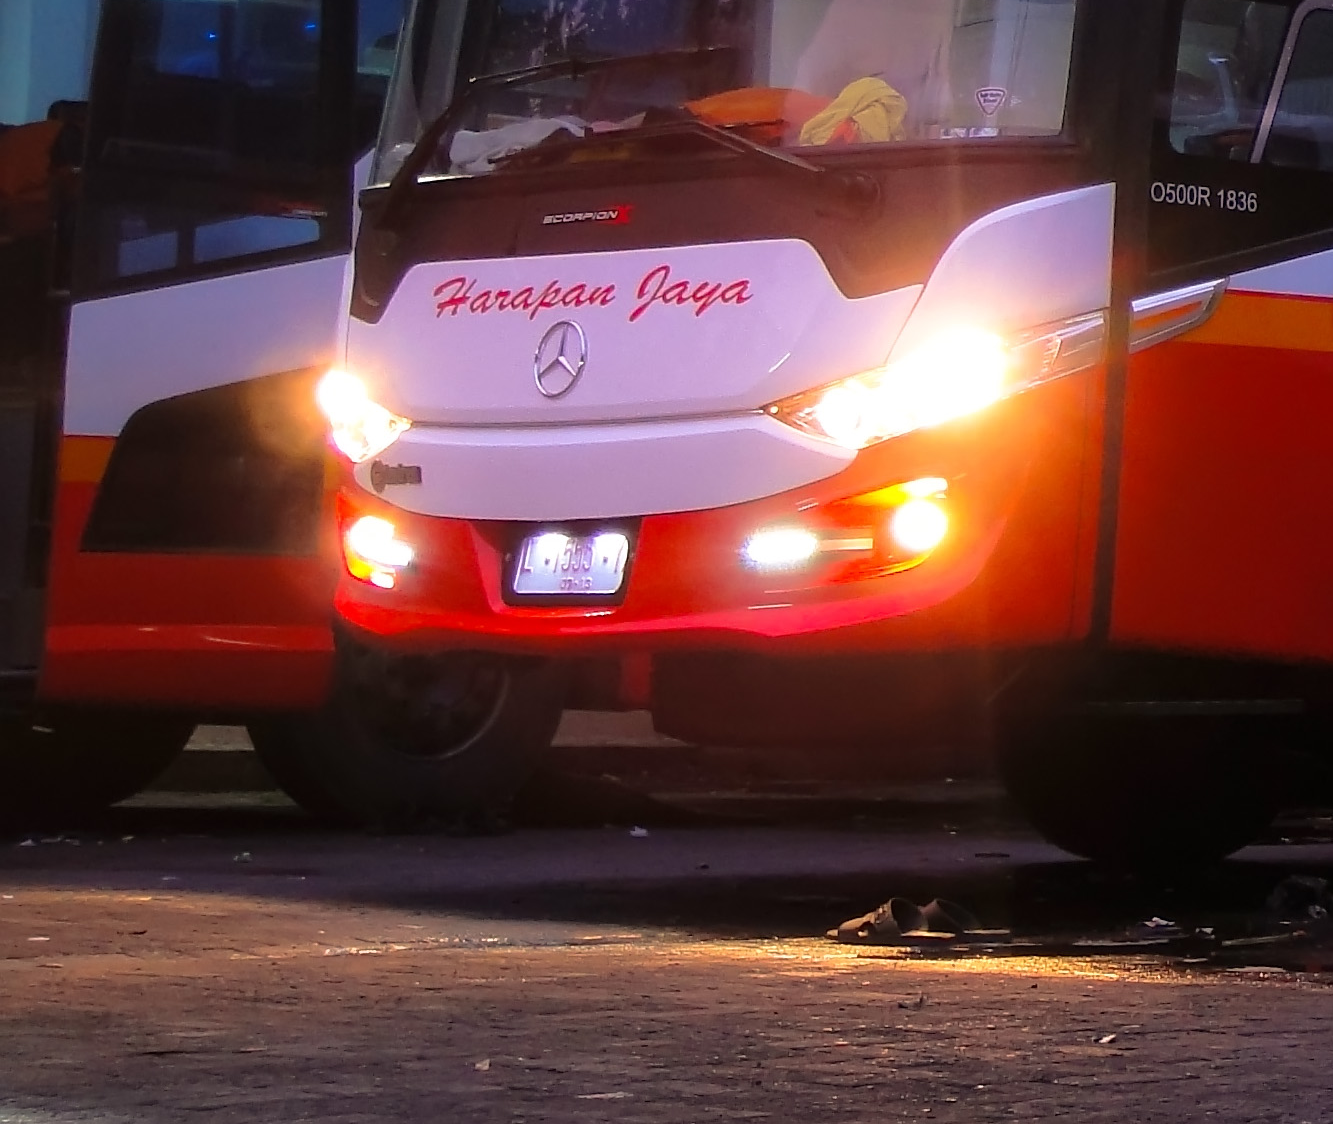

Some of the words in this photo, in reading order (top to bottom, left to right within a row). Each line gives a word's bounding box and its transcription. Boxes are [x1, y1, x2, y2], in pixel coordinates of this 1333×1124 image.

[1216, 189, 1258, 212] 1836
[433, 276, 616, 320] Harapan
[628, 265, 754, 322] Jaya
